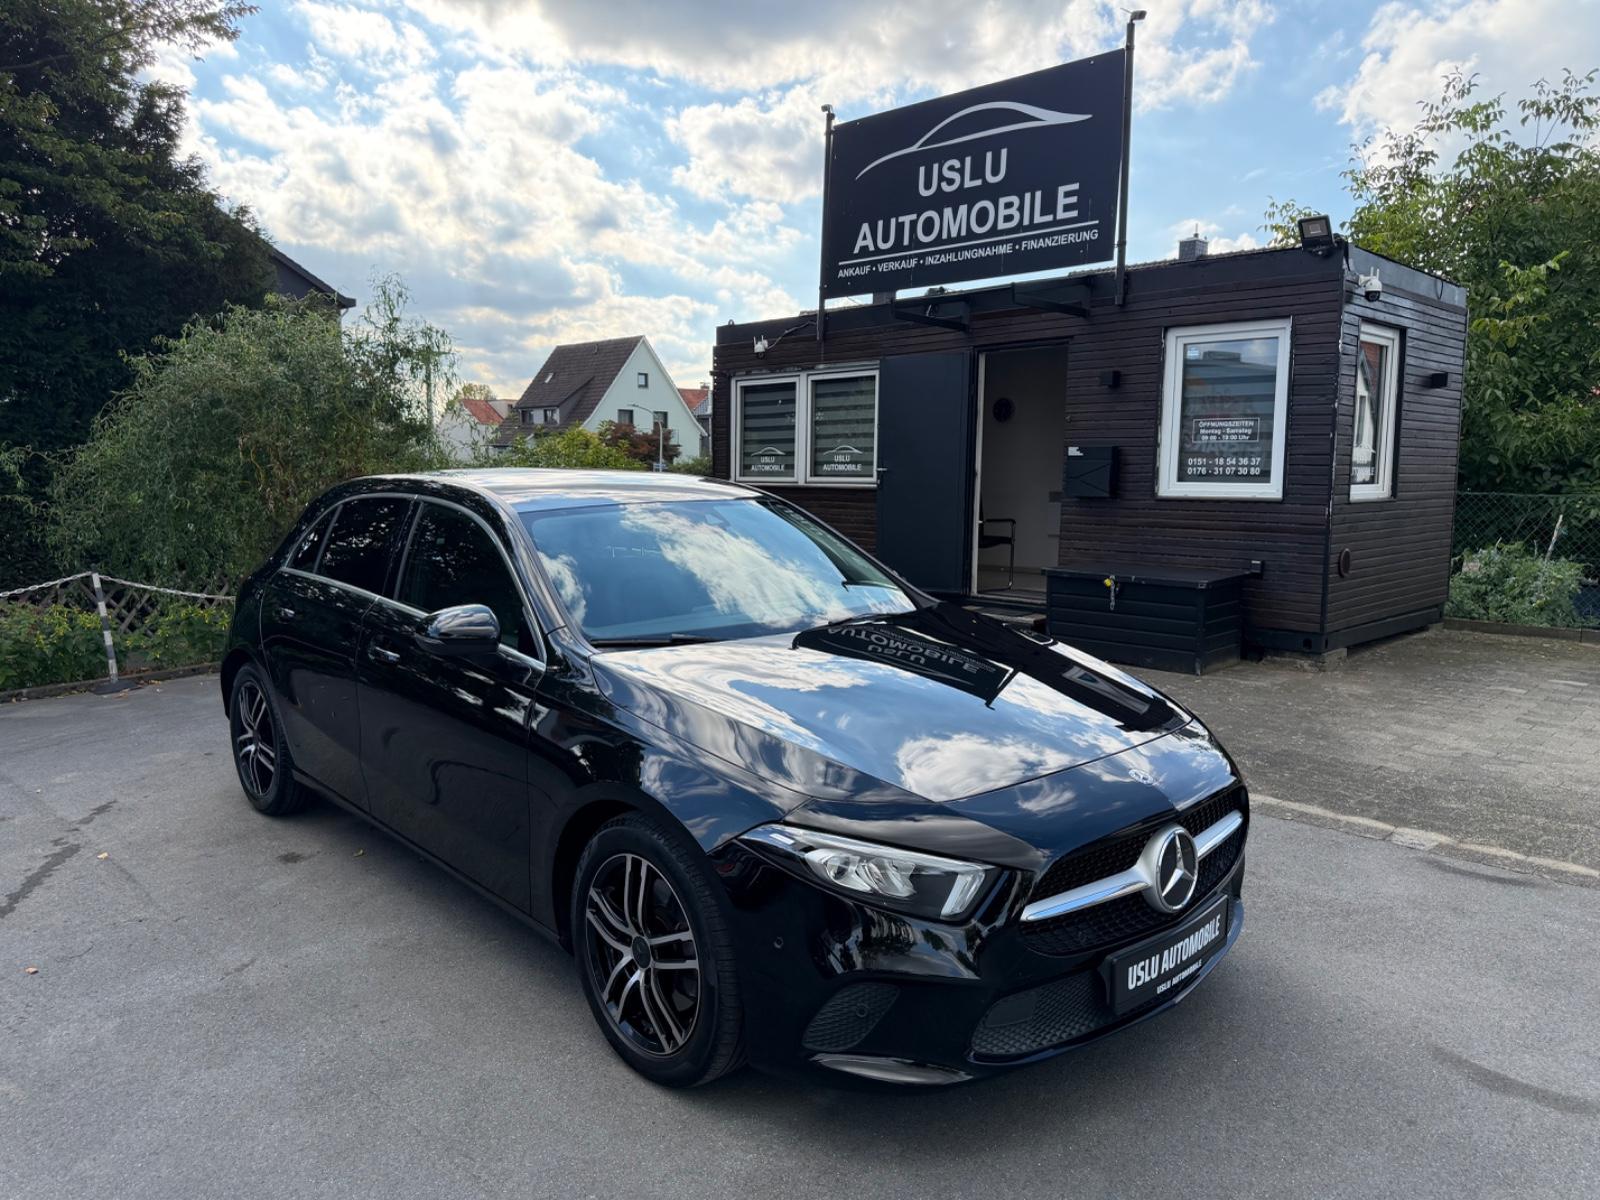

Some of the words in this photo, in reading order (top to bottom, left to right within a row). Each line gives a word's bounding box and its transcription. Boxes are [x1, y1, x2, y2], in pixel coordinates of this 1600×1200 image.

[918, 148, 1007, 196] USLU
[853, 182, 1080, 254] AUTOMOBILE
[837, 264, 872, 278] ANKAUF
[877, 258, 919, 272] VERKAUF
[925, 243, 1013, 265] INZAHLUNGNAHME
[1021, 229, 1099, 251] FINANZIERUNG
[823, 463, 862, 471] AUTOMOBILE
[1251, 457, 1261, 465] 37
[1127, 954, 1160, 990] USLU
[1161, 914, 1221, 974] AUTOMOBILE
[1157, 980, 1171, 994] USLU
[1171, 959, 1202, 986] AUTOMOBILE
